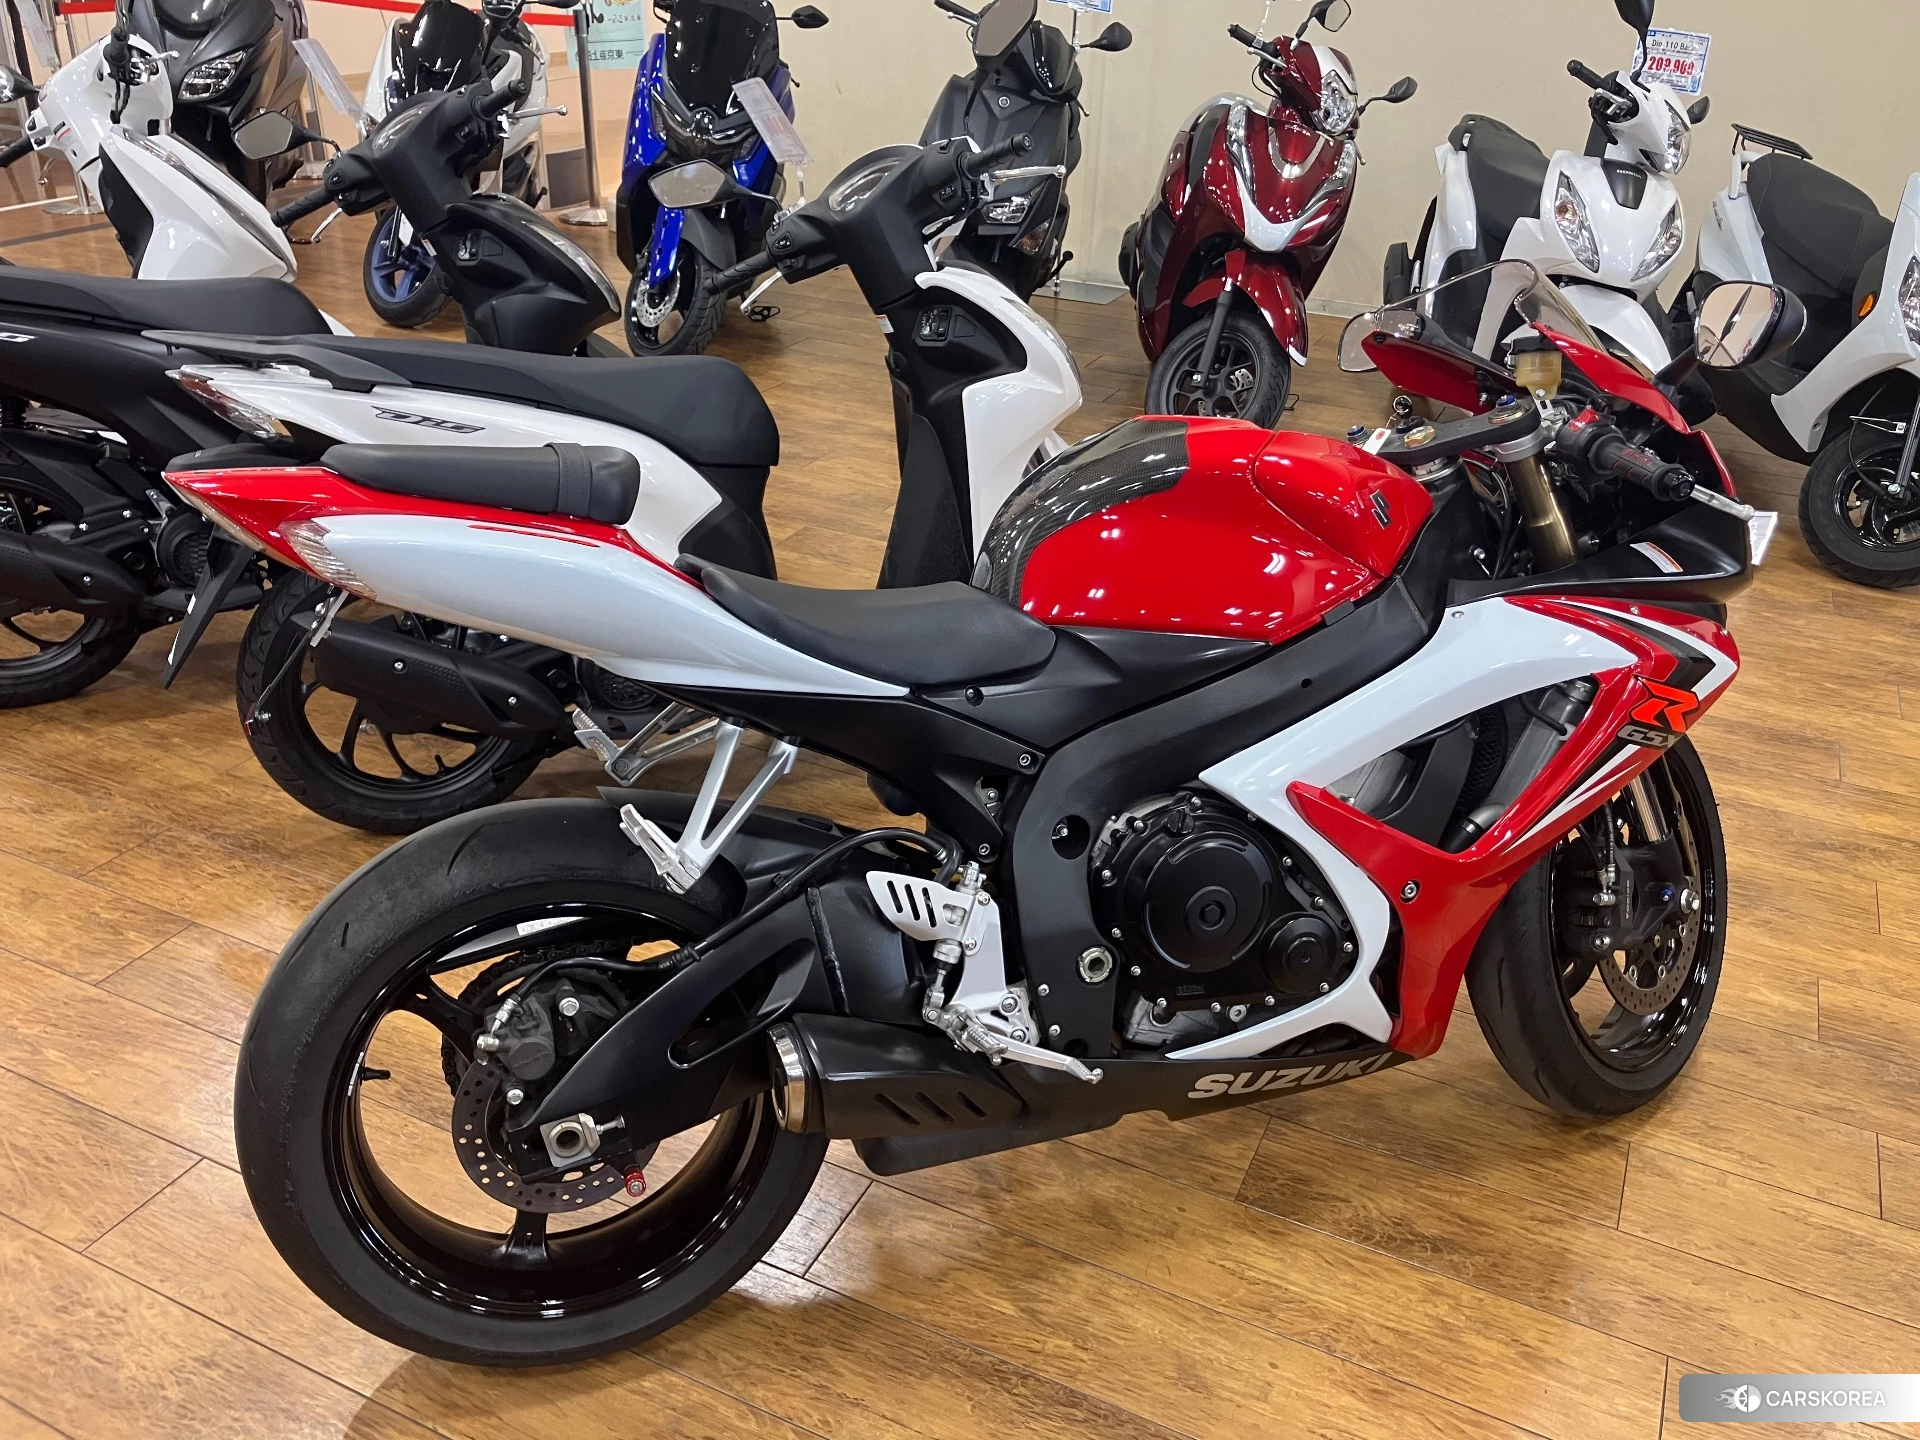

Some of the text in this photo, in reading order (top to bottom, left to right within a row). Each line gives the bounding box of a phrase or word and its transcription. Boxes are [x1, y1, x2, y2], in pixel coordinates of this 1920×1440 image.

[1666, 41, 1679, 49] 110
[1630, 676, 1699, 733] R
[1187, 1052, 1393, 1099] SUZUKI
